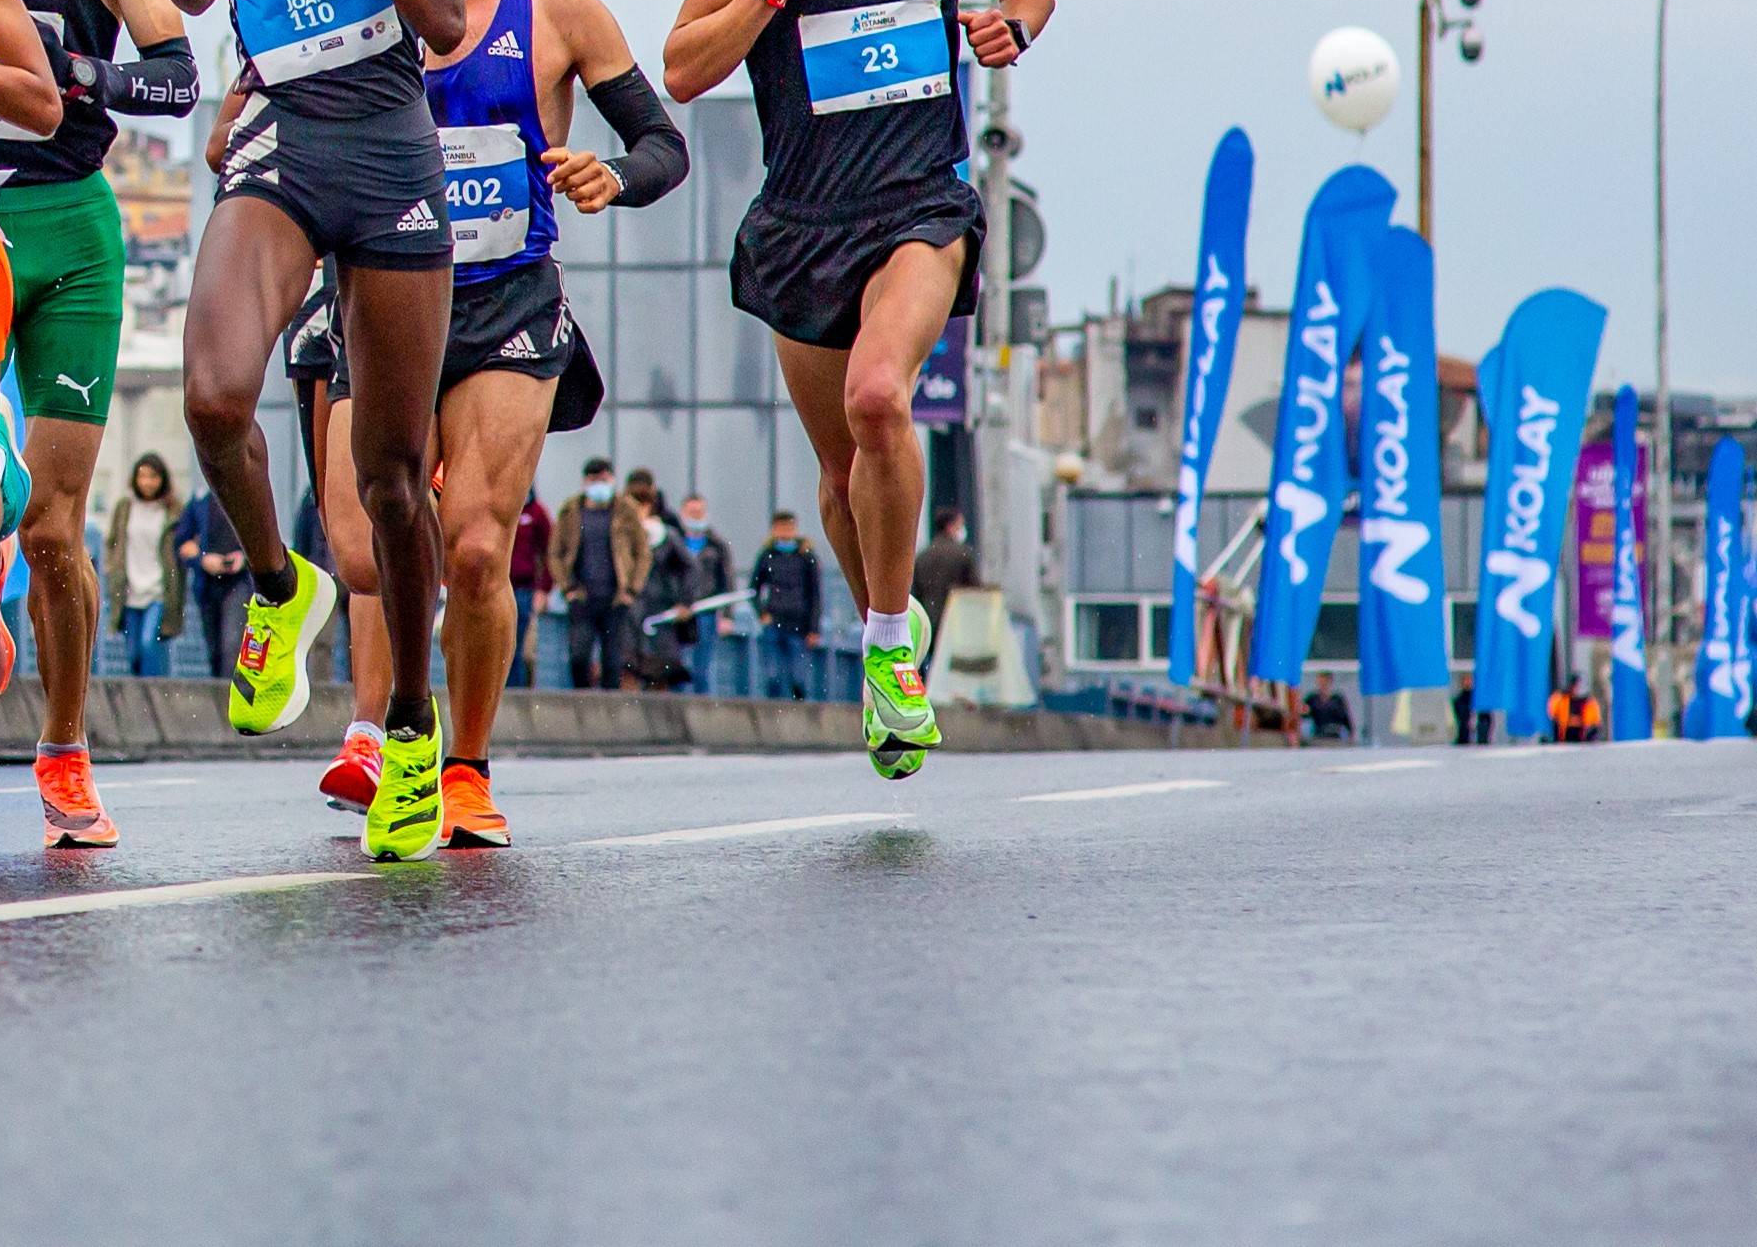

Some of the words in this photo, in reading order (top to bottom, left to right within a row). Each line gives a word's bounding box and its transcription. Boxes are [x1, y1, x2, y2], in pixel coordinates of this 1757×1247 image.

[290, 2, 335, 31] 110
[487, 46, 524, 59] adidas
[861, 43, 899, 73] 23
[444, 177, 502, 207] 402
[397, 219, 439, 232] adidas
